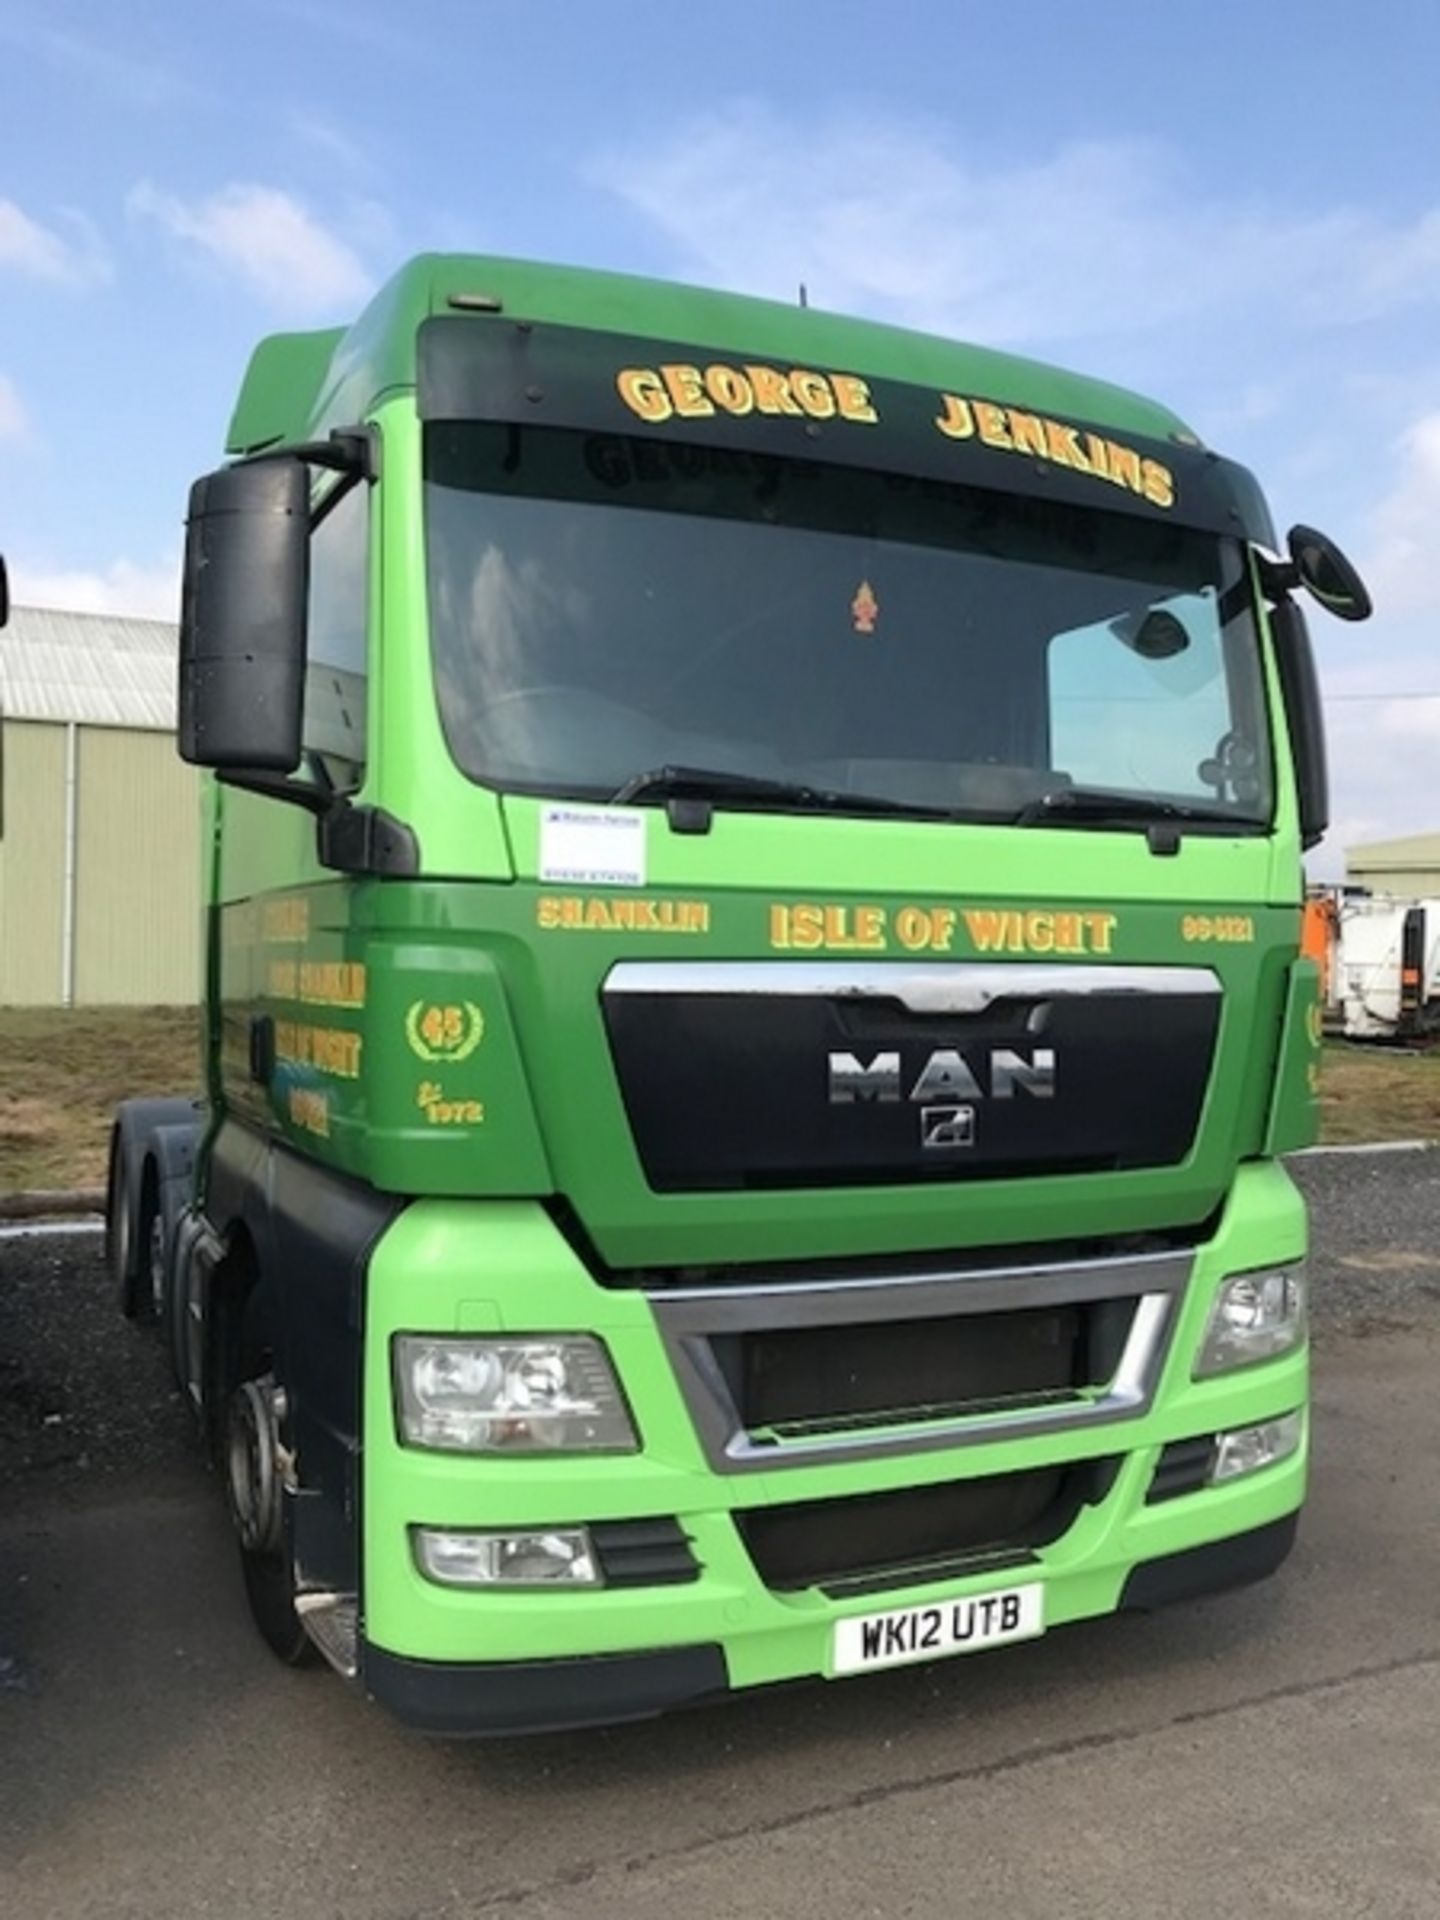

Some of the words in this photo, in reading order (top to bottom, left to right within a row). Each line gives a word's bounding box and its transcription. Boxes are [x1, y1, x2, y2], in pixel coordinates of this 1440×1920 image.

[616, 364, 878, 423] GEORGE
[935, 394, 1174, 508] JENKINS
[537, 897, 709, 933] SHANKLIN
[769, 904, 887, 951] ISLE
[897, 907, 954, 951] OF
[962, 909, 1118, 955] WIGHT
[421, 1006, 463, 1048] 45
[828, 1049, 1055, 1103] MAN
[428, 1101, 484, 1123] 1972
[861, 1608, 942, 1660] WK12
[951, 1594, 1021, 1640] UTB
